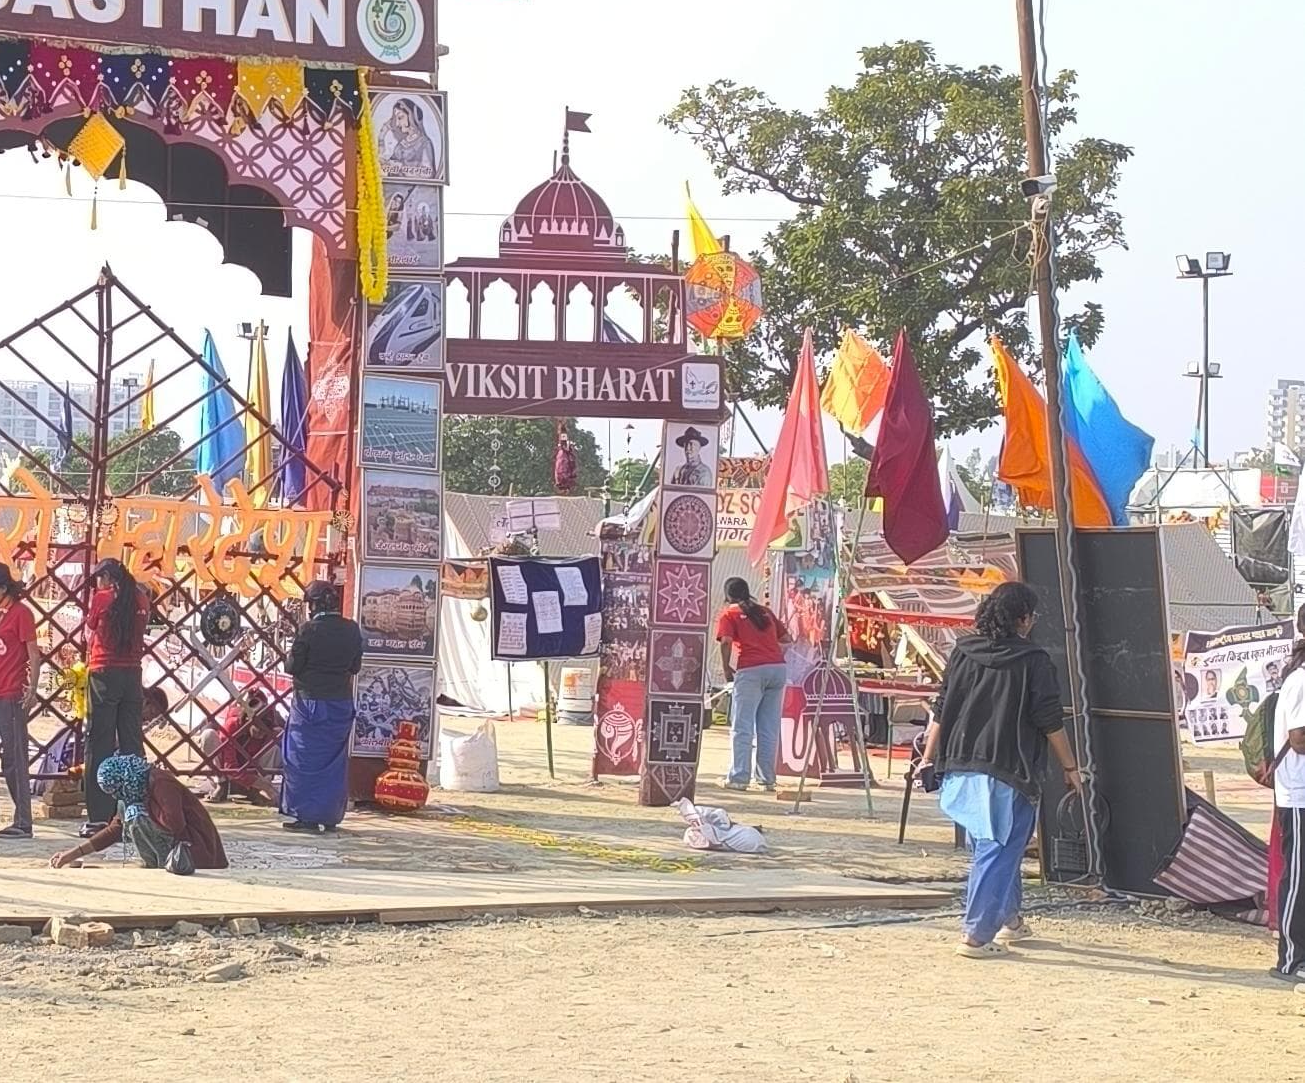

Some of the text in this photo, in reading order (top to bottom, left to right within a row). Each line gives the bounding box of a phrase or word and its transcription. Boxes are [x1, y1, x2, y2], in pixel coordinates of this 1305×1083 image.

[445, 362, 675, 403] VIKSIT BHARAT
[716, 516, 748, 527] WARA
